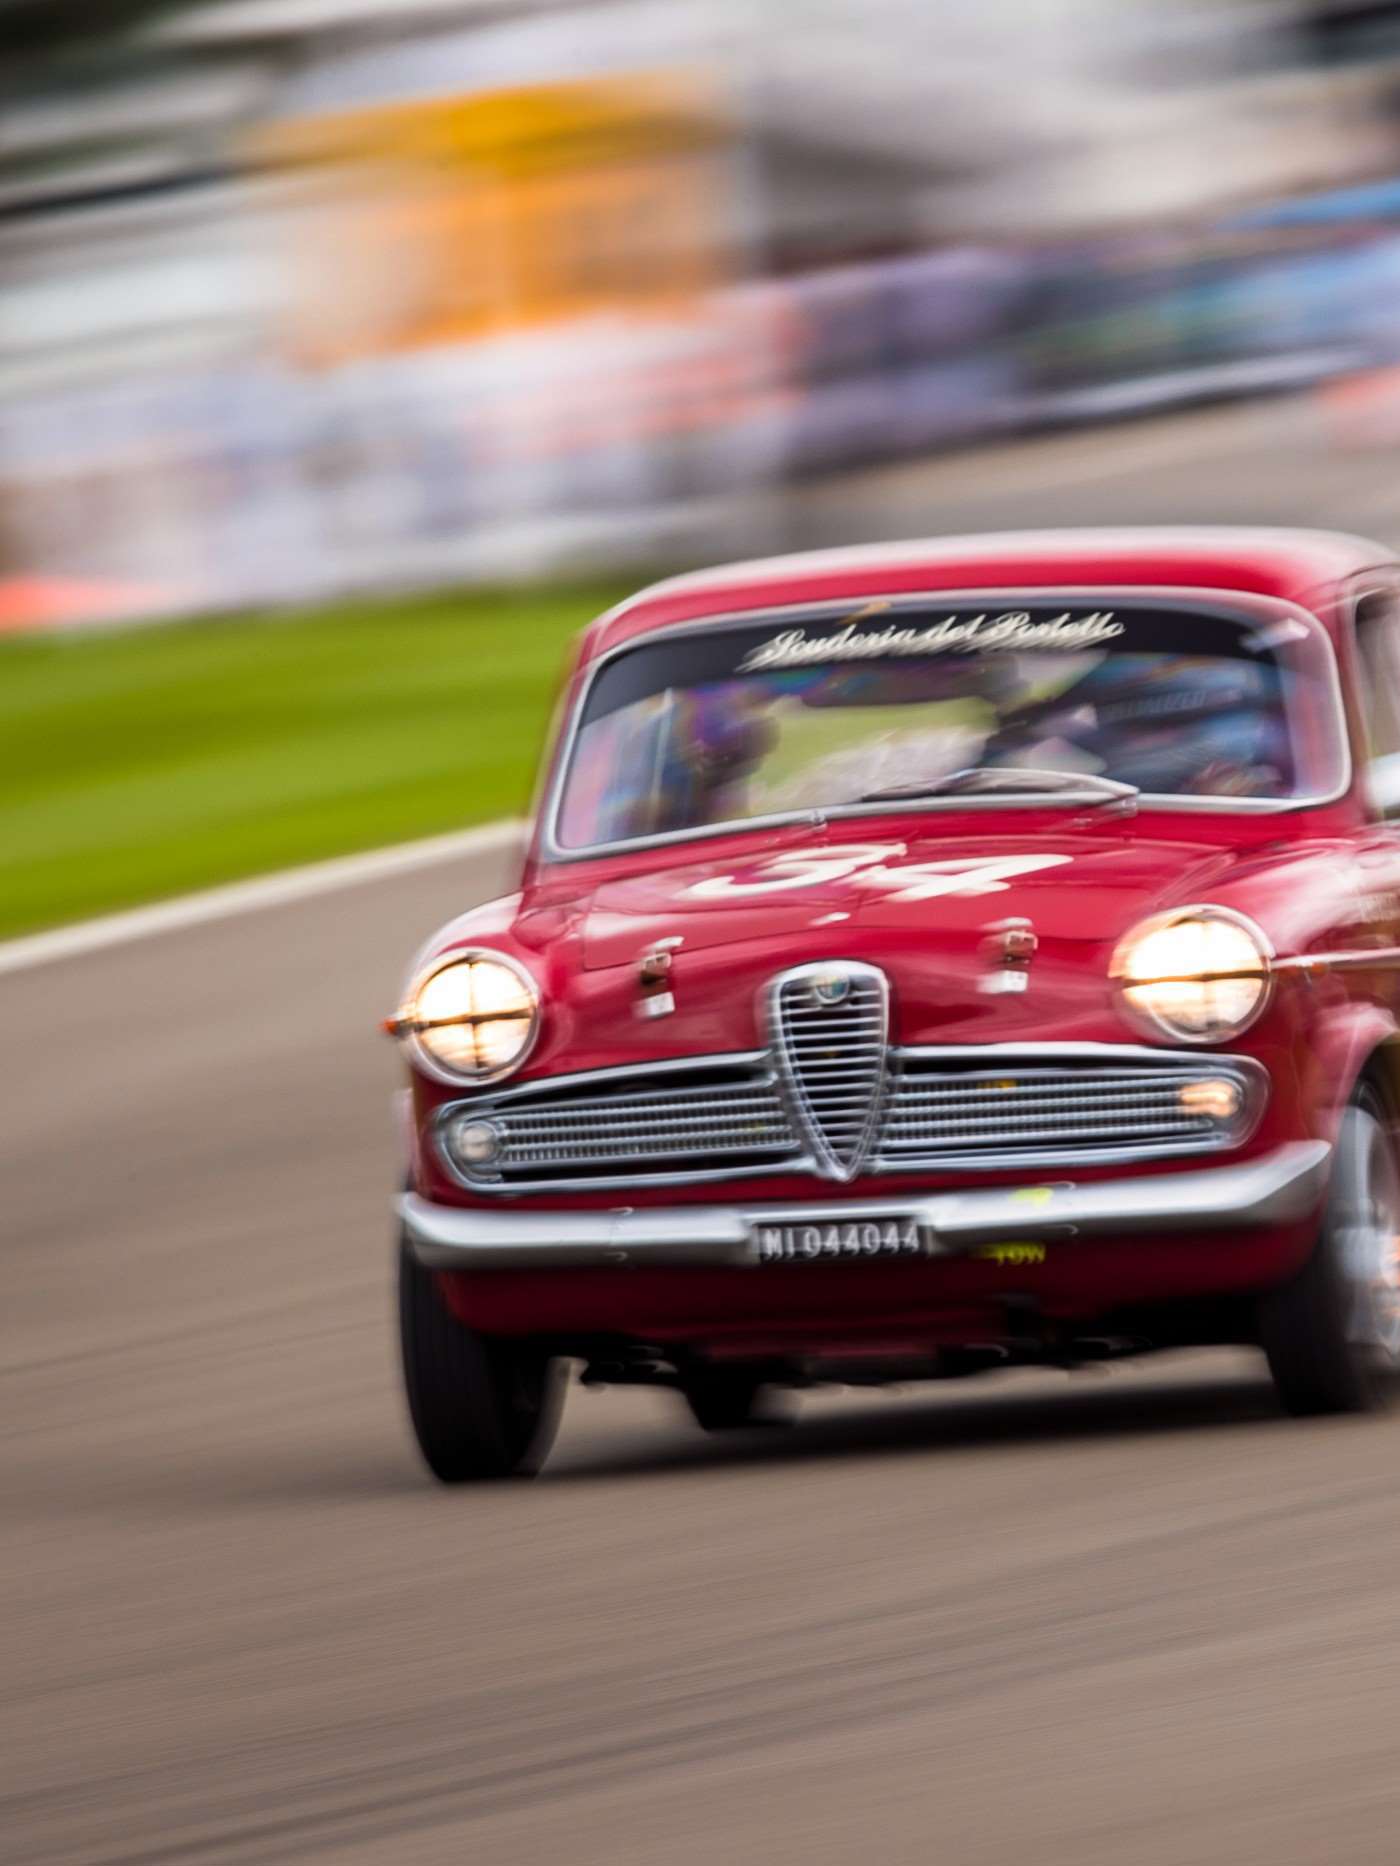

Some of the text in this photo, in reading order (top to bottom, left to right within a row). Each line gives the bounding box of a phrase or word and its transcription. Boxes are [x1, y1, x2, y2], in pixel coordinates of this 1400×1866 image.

[734, 611, 1125, 673] Scuderia del Portello
[682, 843, 1075, 900] 34
